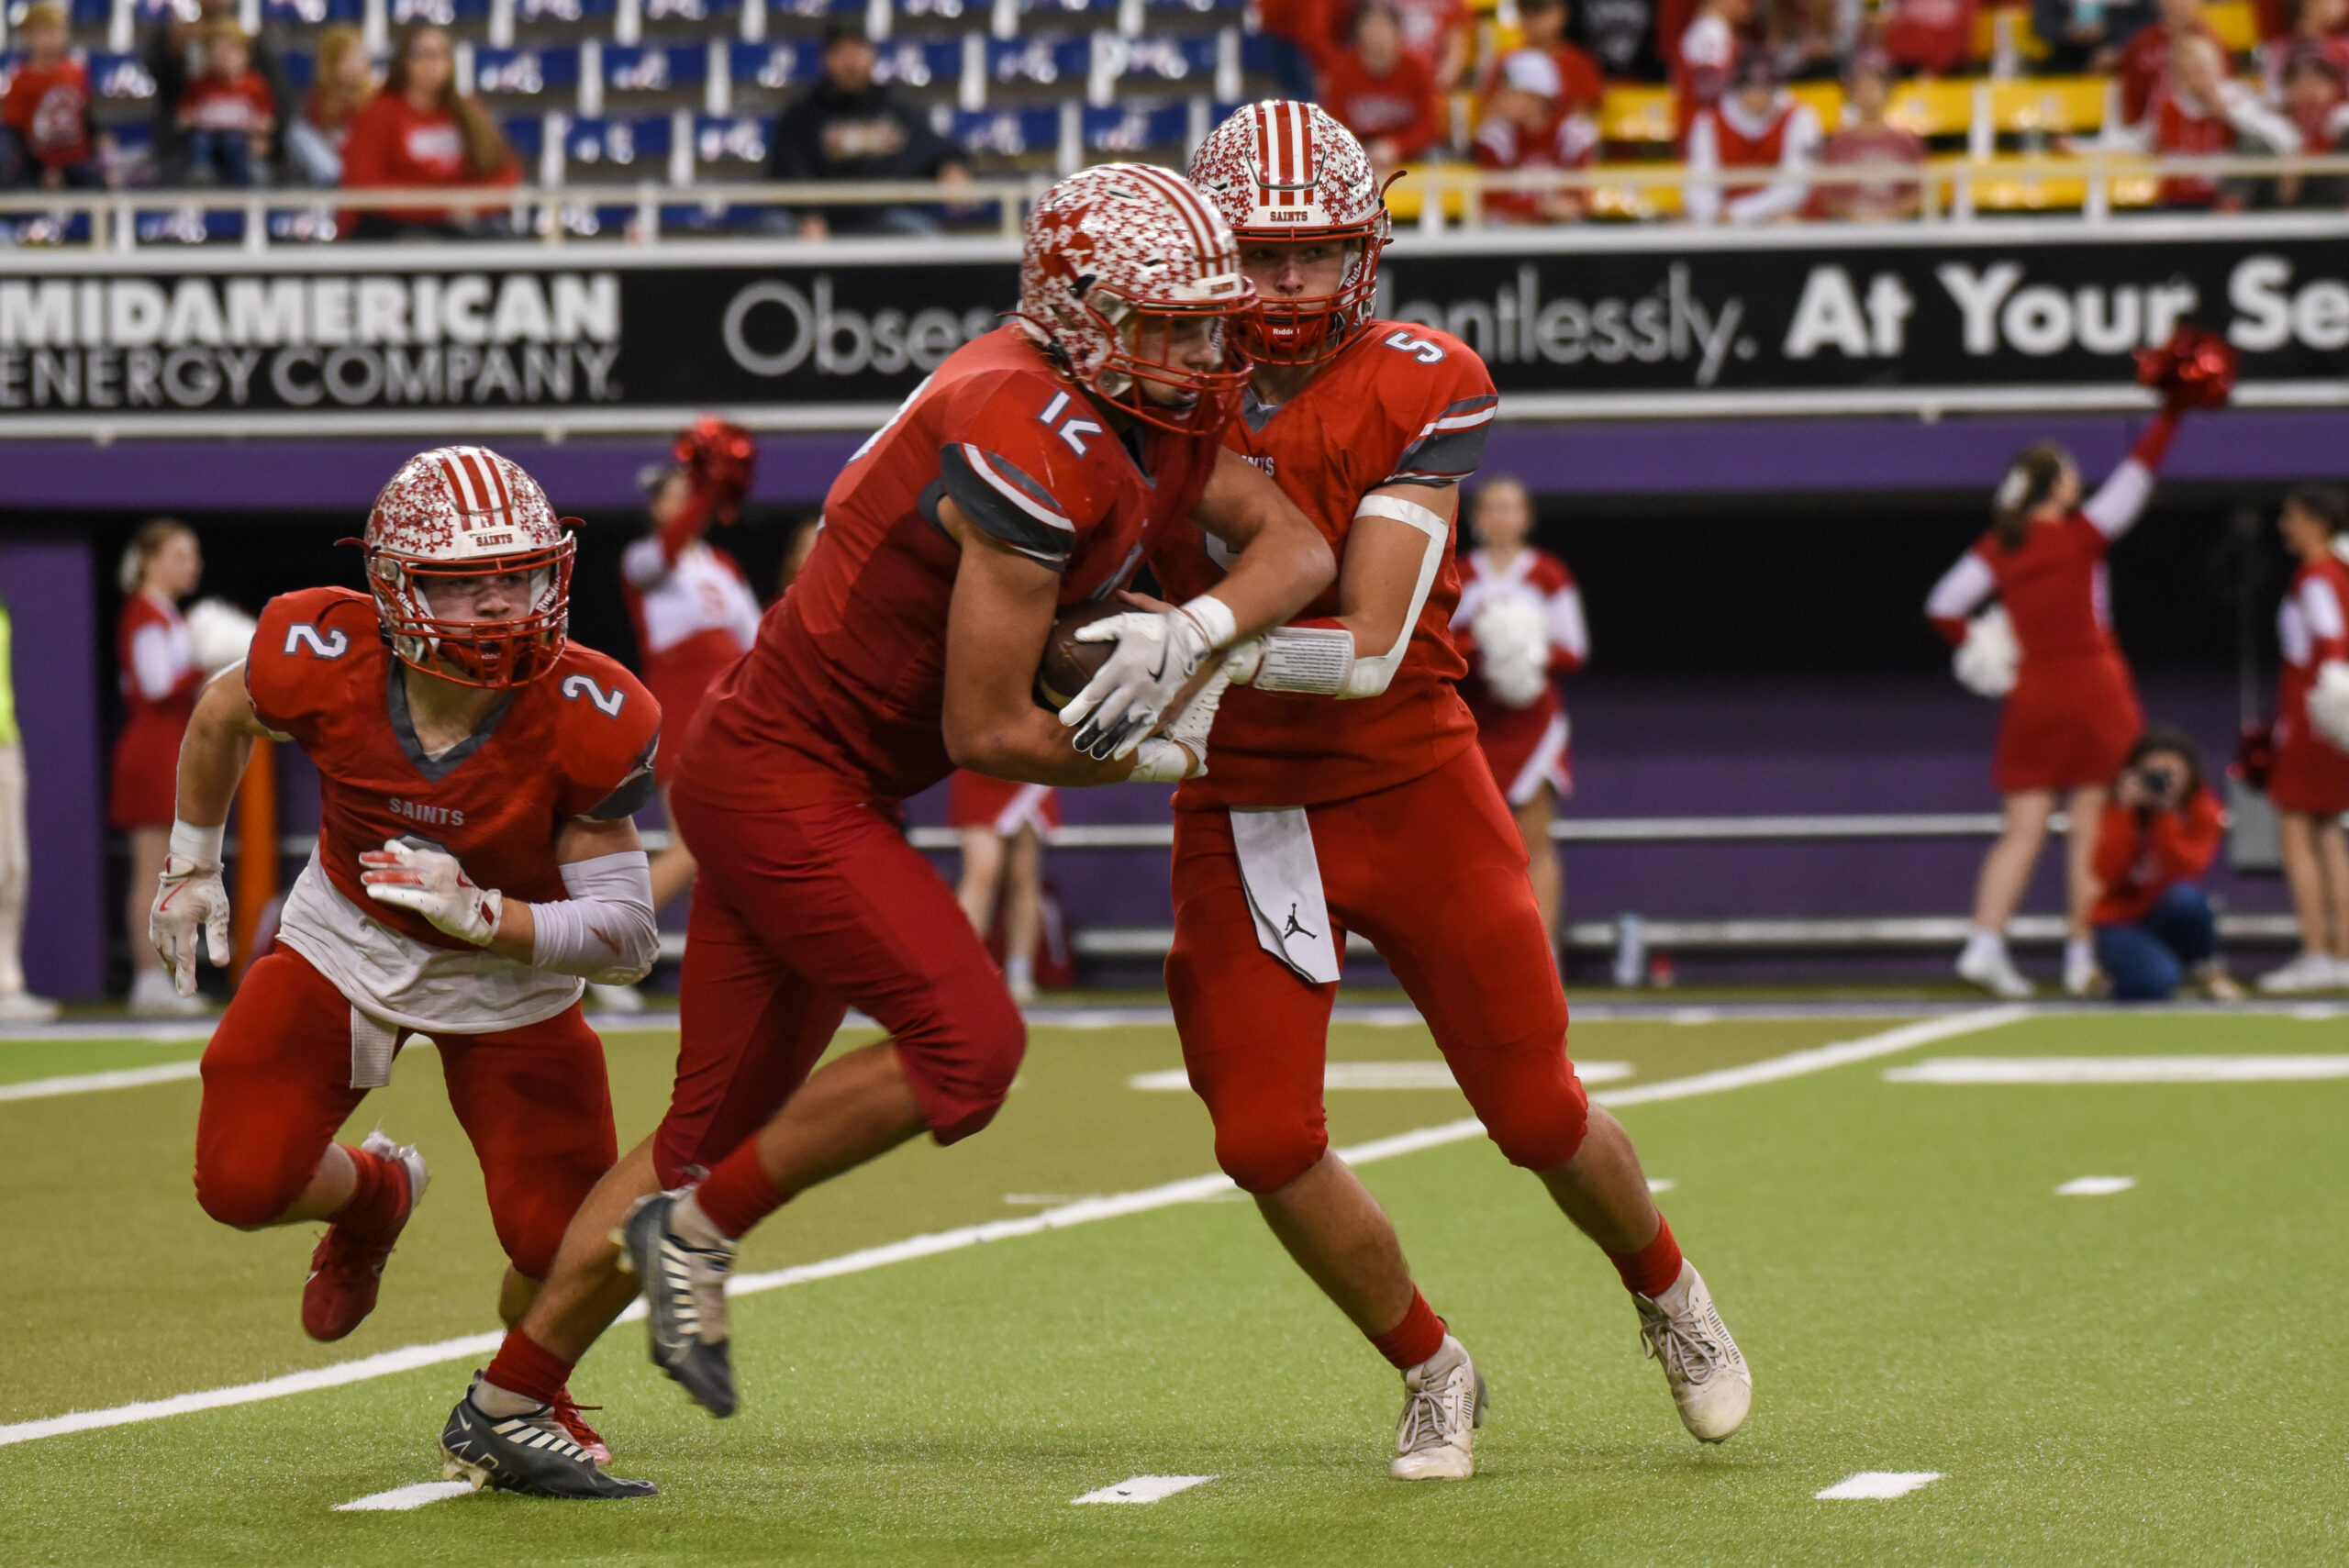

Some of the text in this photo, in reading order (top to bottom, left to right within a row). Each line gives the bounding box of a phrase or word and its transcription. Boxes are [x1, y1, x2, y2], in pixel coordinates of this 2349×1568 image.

[1270, 211, 1308, 222] SAINTS
[0, 275, 620, 348] MIDAMERICAN
[722, 273, 1002, 377] Obses
[1783, 263, 1914, 359] At
[1935, 261, 2200, 355] Your
[1382, 329, 1447, 364] 5
[0, 345, 262, 407] ENERGY
[476, 533, 513, 547] SAINTS
[283, 622, 349, 661] 2
[560, 673, 626, 719] 2
[389, 797, 464, 827] SAINTS
